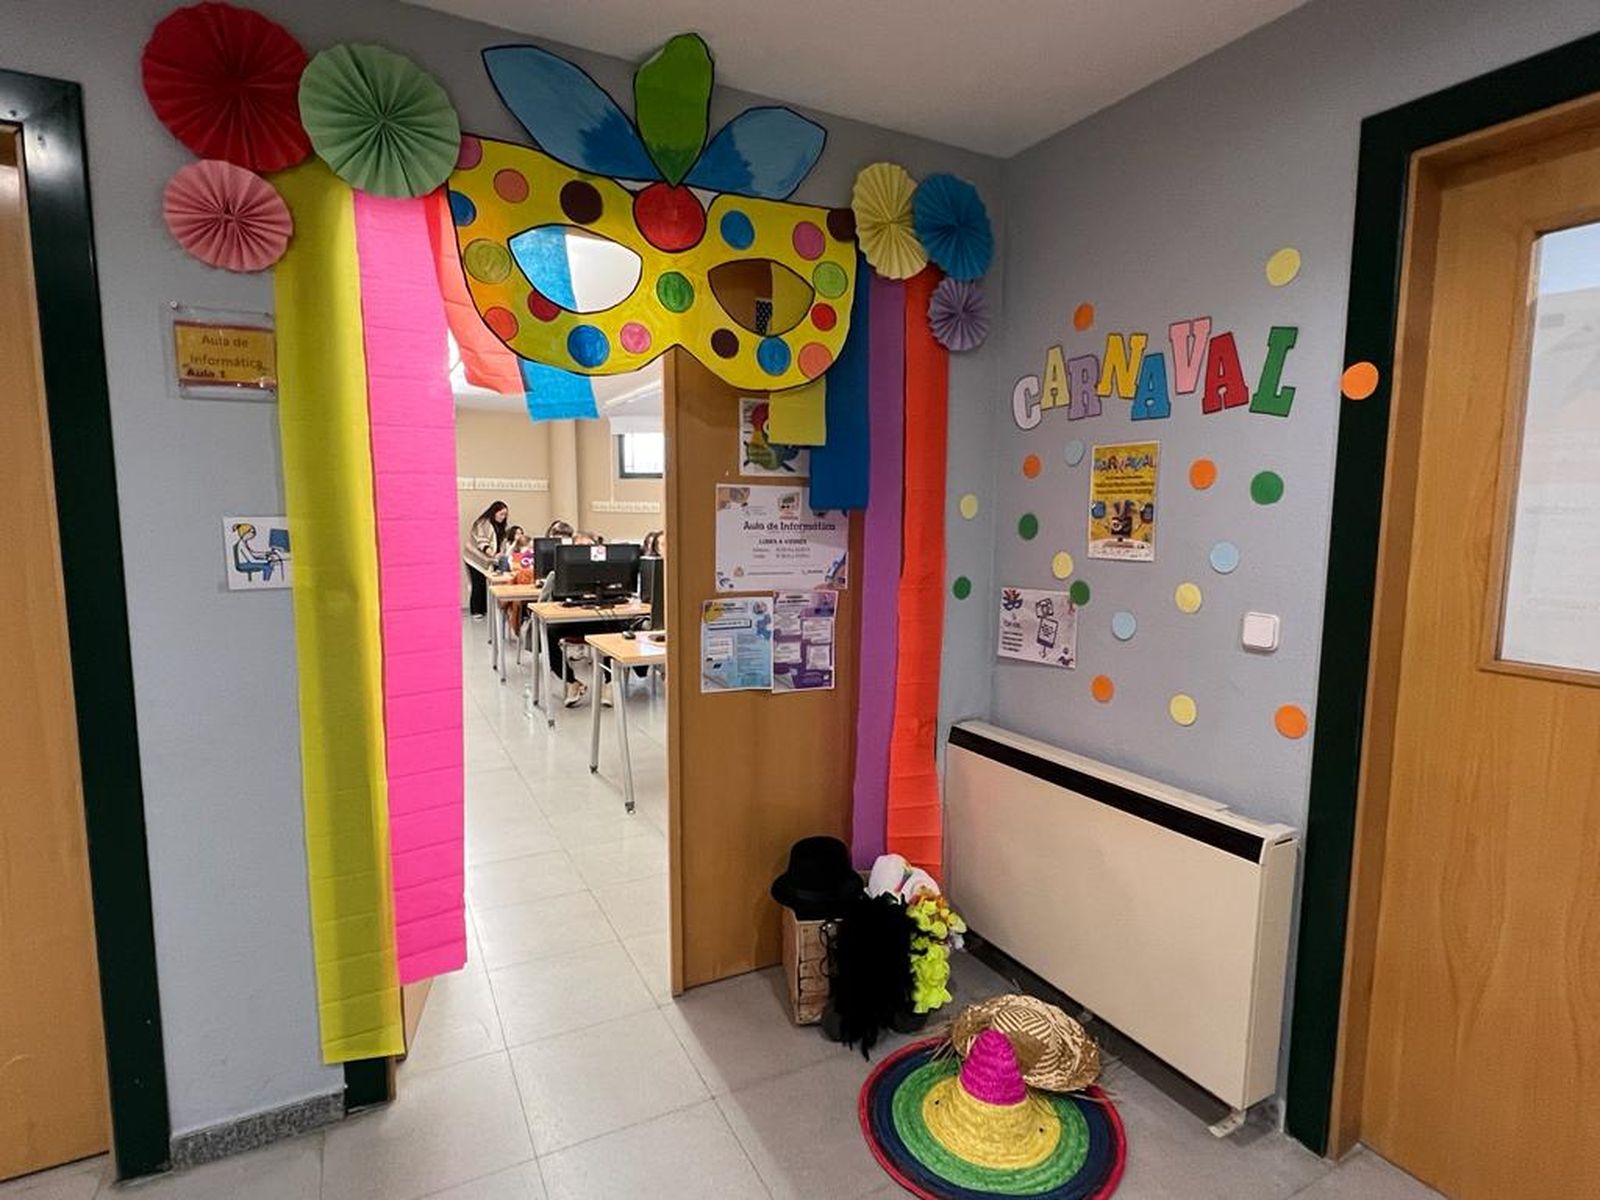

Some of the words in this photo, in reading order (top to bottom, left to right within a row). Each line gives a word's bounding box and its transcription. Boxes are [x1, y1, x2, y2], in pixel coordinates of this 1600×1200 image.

[202, 335, 230, 347] Aula
[233, 337, 248, 348] de
[187, 367, 215, 378] Aula
[1012, 316, 1298, 431] CARNAVAL
[743, 520, 765, 531] Aula
[766, 521, 779, 531] de
